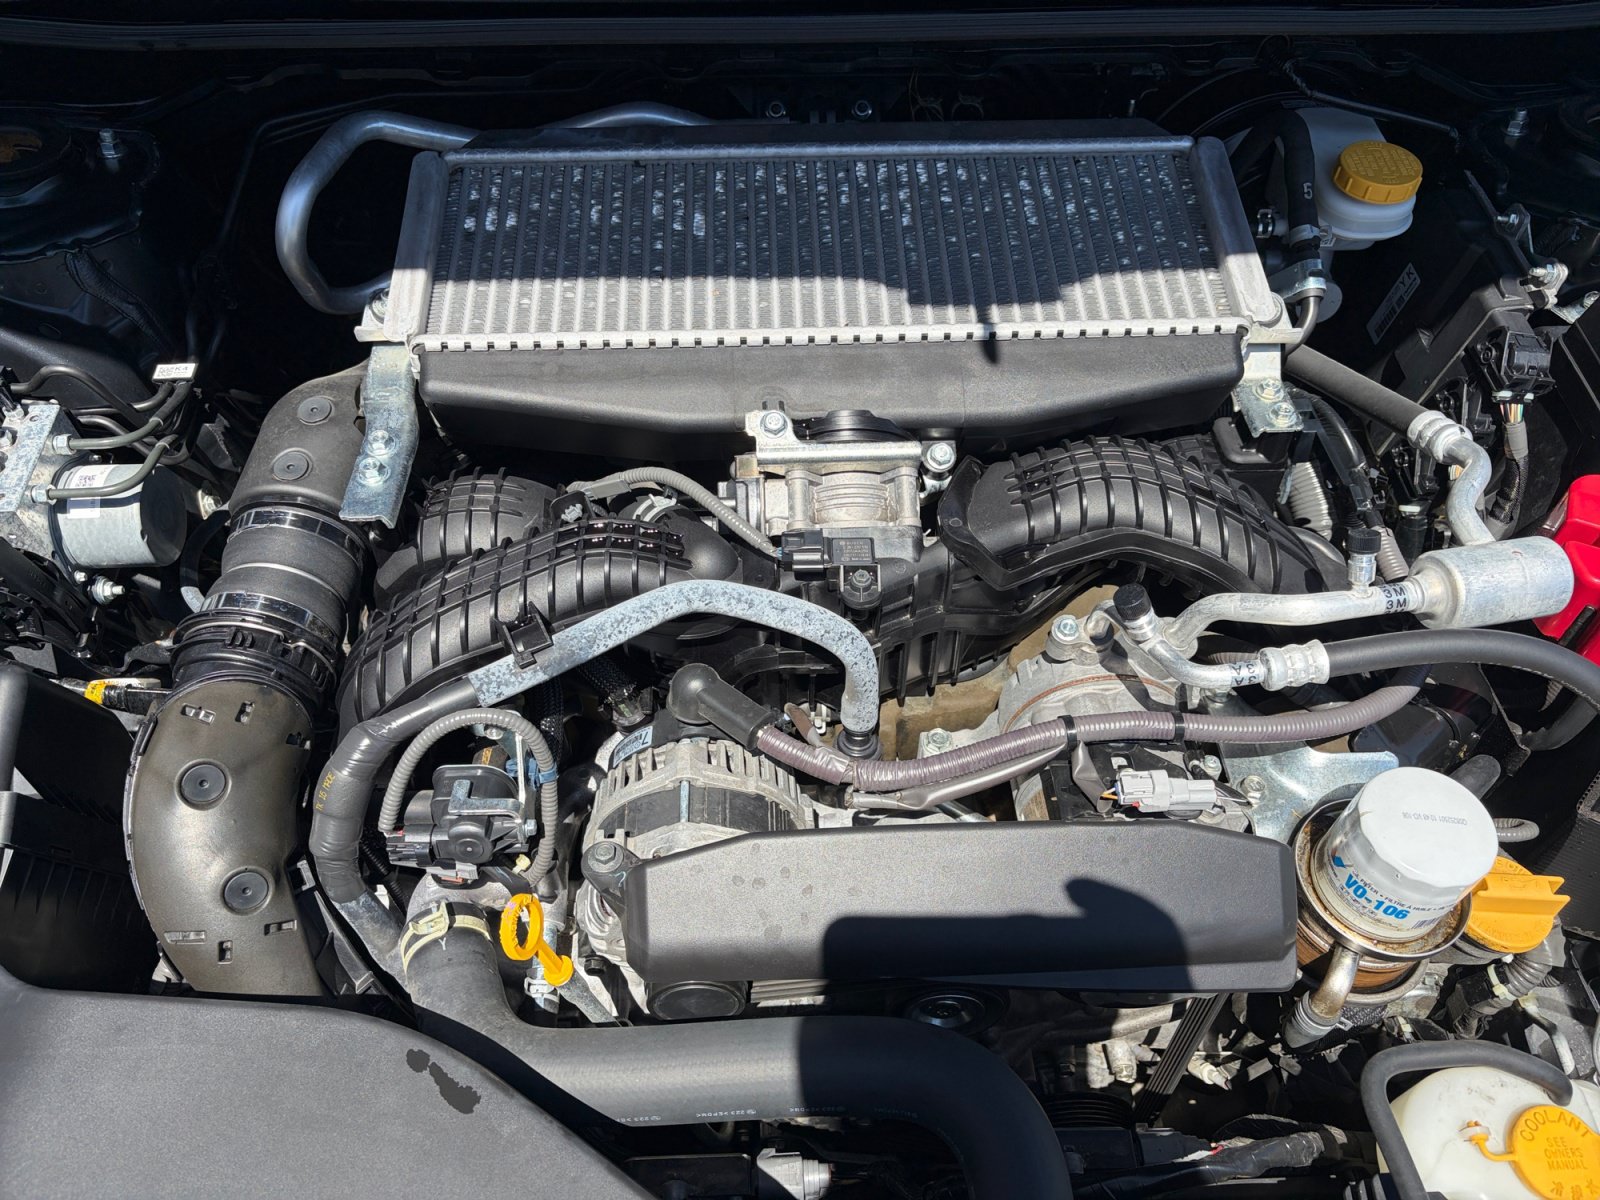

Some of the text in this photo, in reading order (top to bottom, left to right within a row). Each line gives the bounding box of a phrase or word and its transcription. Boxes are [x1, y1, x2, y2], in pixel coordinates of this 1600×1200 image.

[1303, 182, 1313, 200] 5
[1344, 873, 1411, 920] VO-106
[438, 937, 447, 951] Y
[1519, 1109, 1593, 1142] COOLANT
[1546, 1136, 1567, 1148] SEE
[1543, 1147, 1584, 1160] OWNERS
[1546, 1159, 1588, 1171] MANUAL
